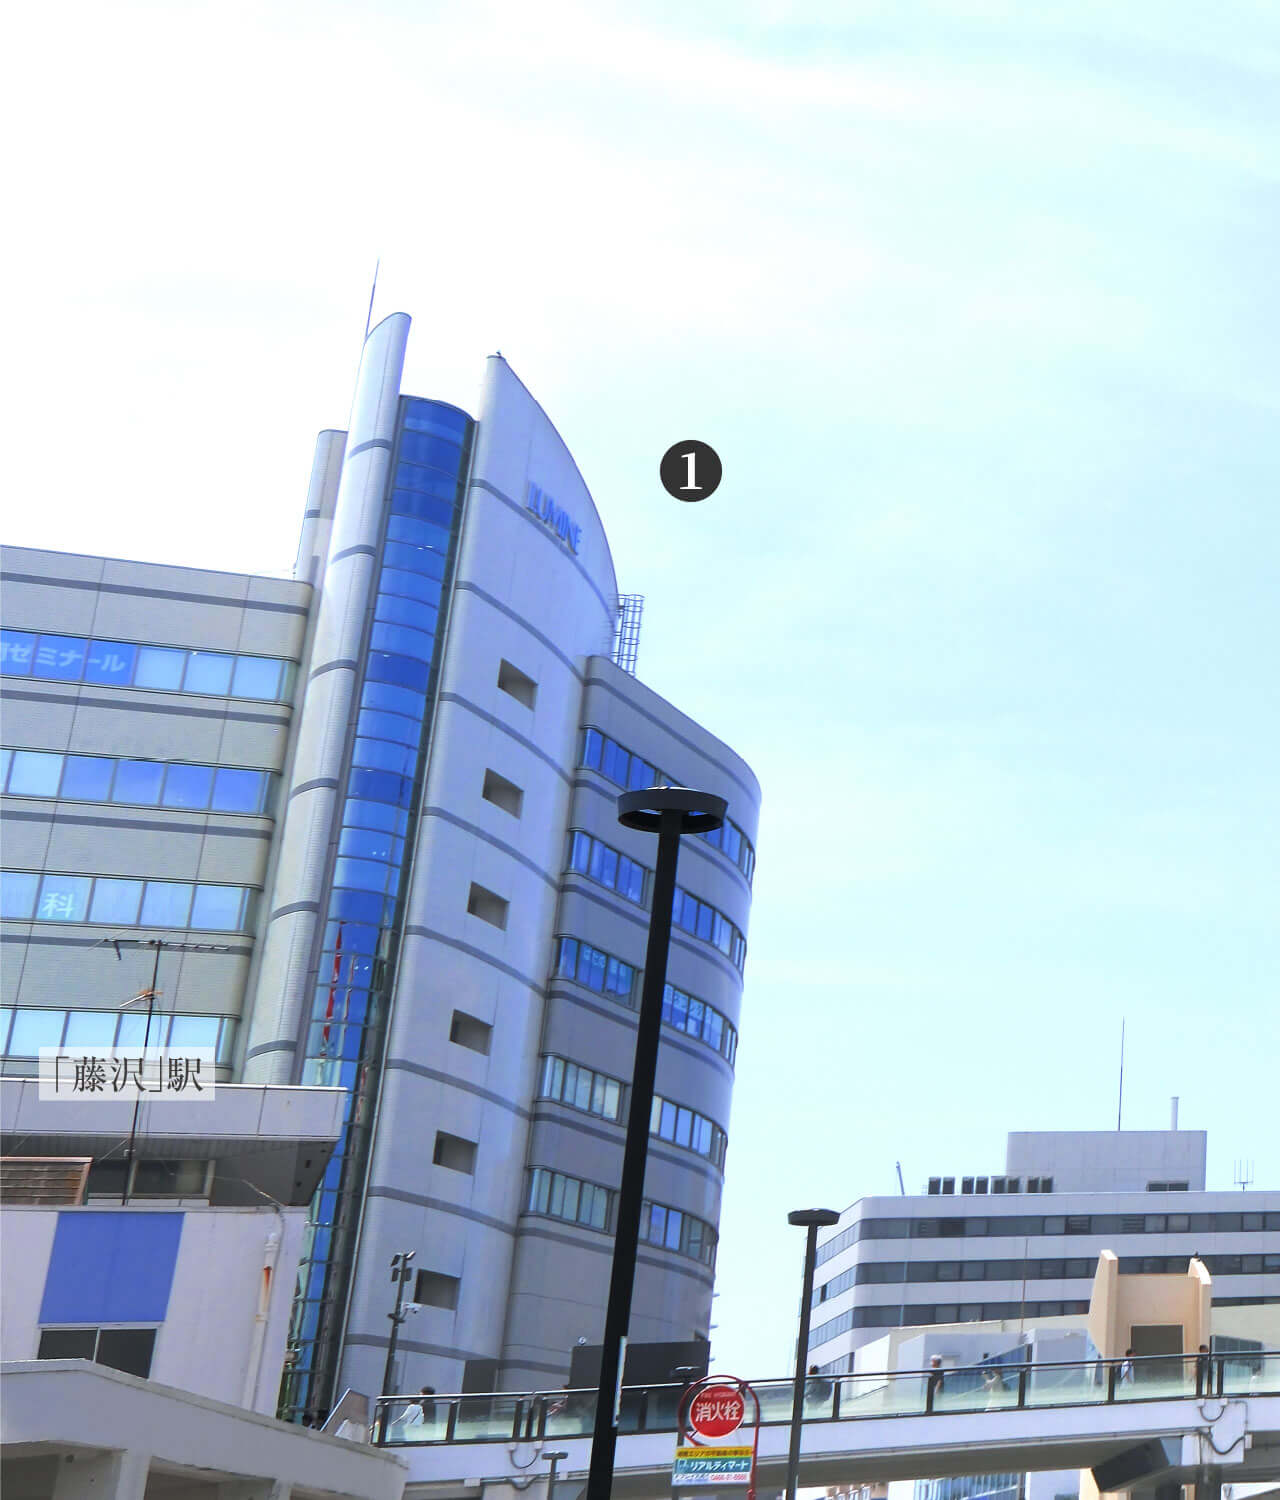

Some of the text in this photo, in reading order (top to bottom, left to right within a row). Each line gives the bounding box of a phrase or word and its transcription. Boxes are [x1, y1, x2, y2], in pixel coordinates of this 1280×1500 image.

[527, 481, 582, 555] LUMINE
[42, 892, 74, 918] 科
[695, 1400, 741, 1422] 消火栓
[690, 1460, 750, 1473] リアルティマート
